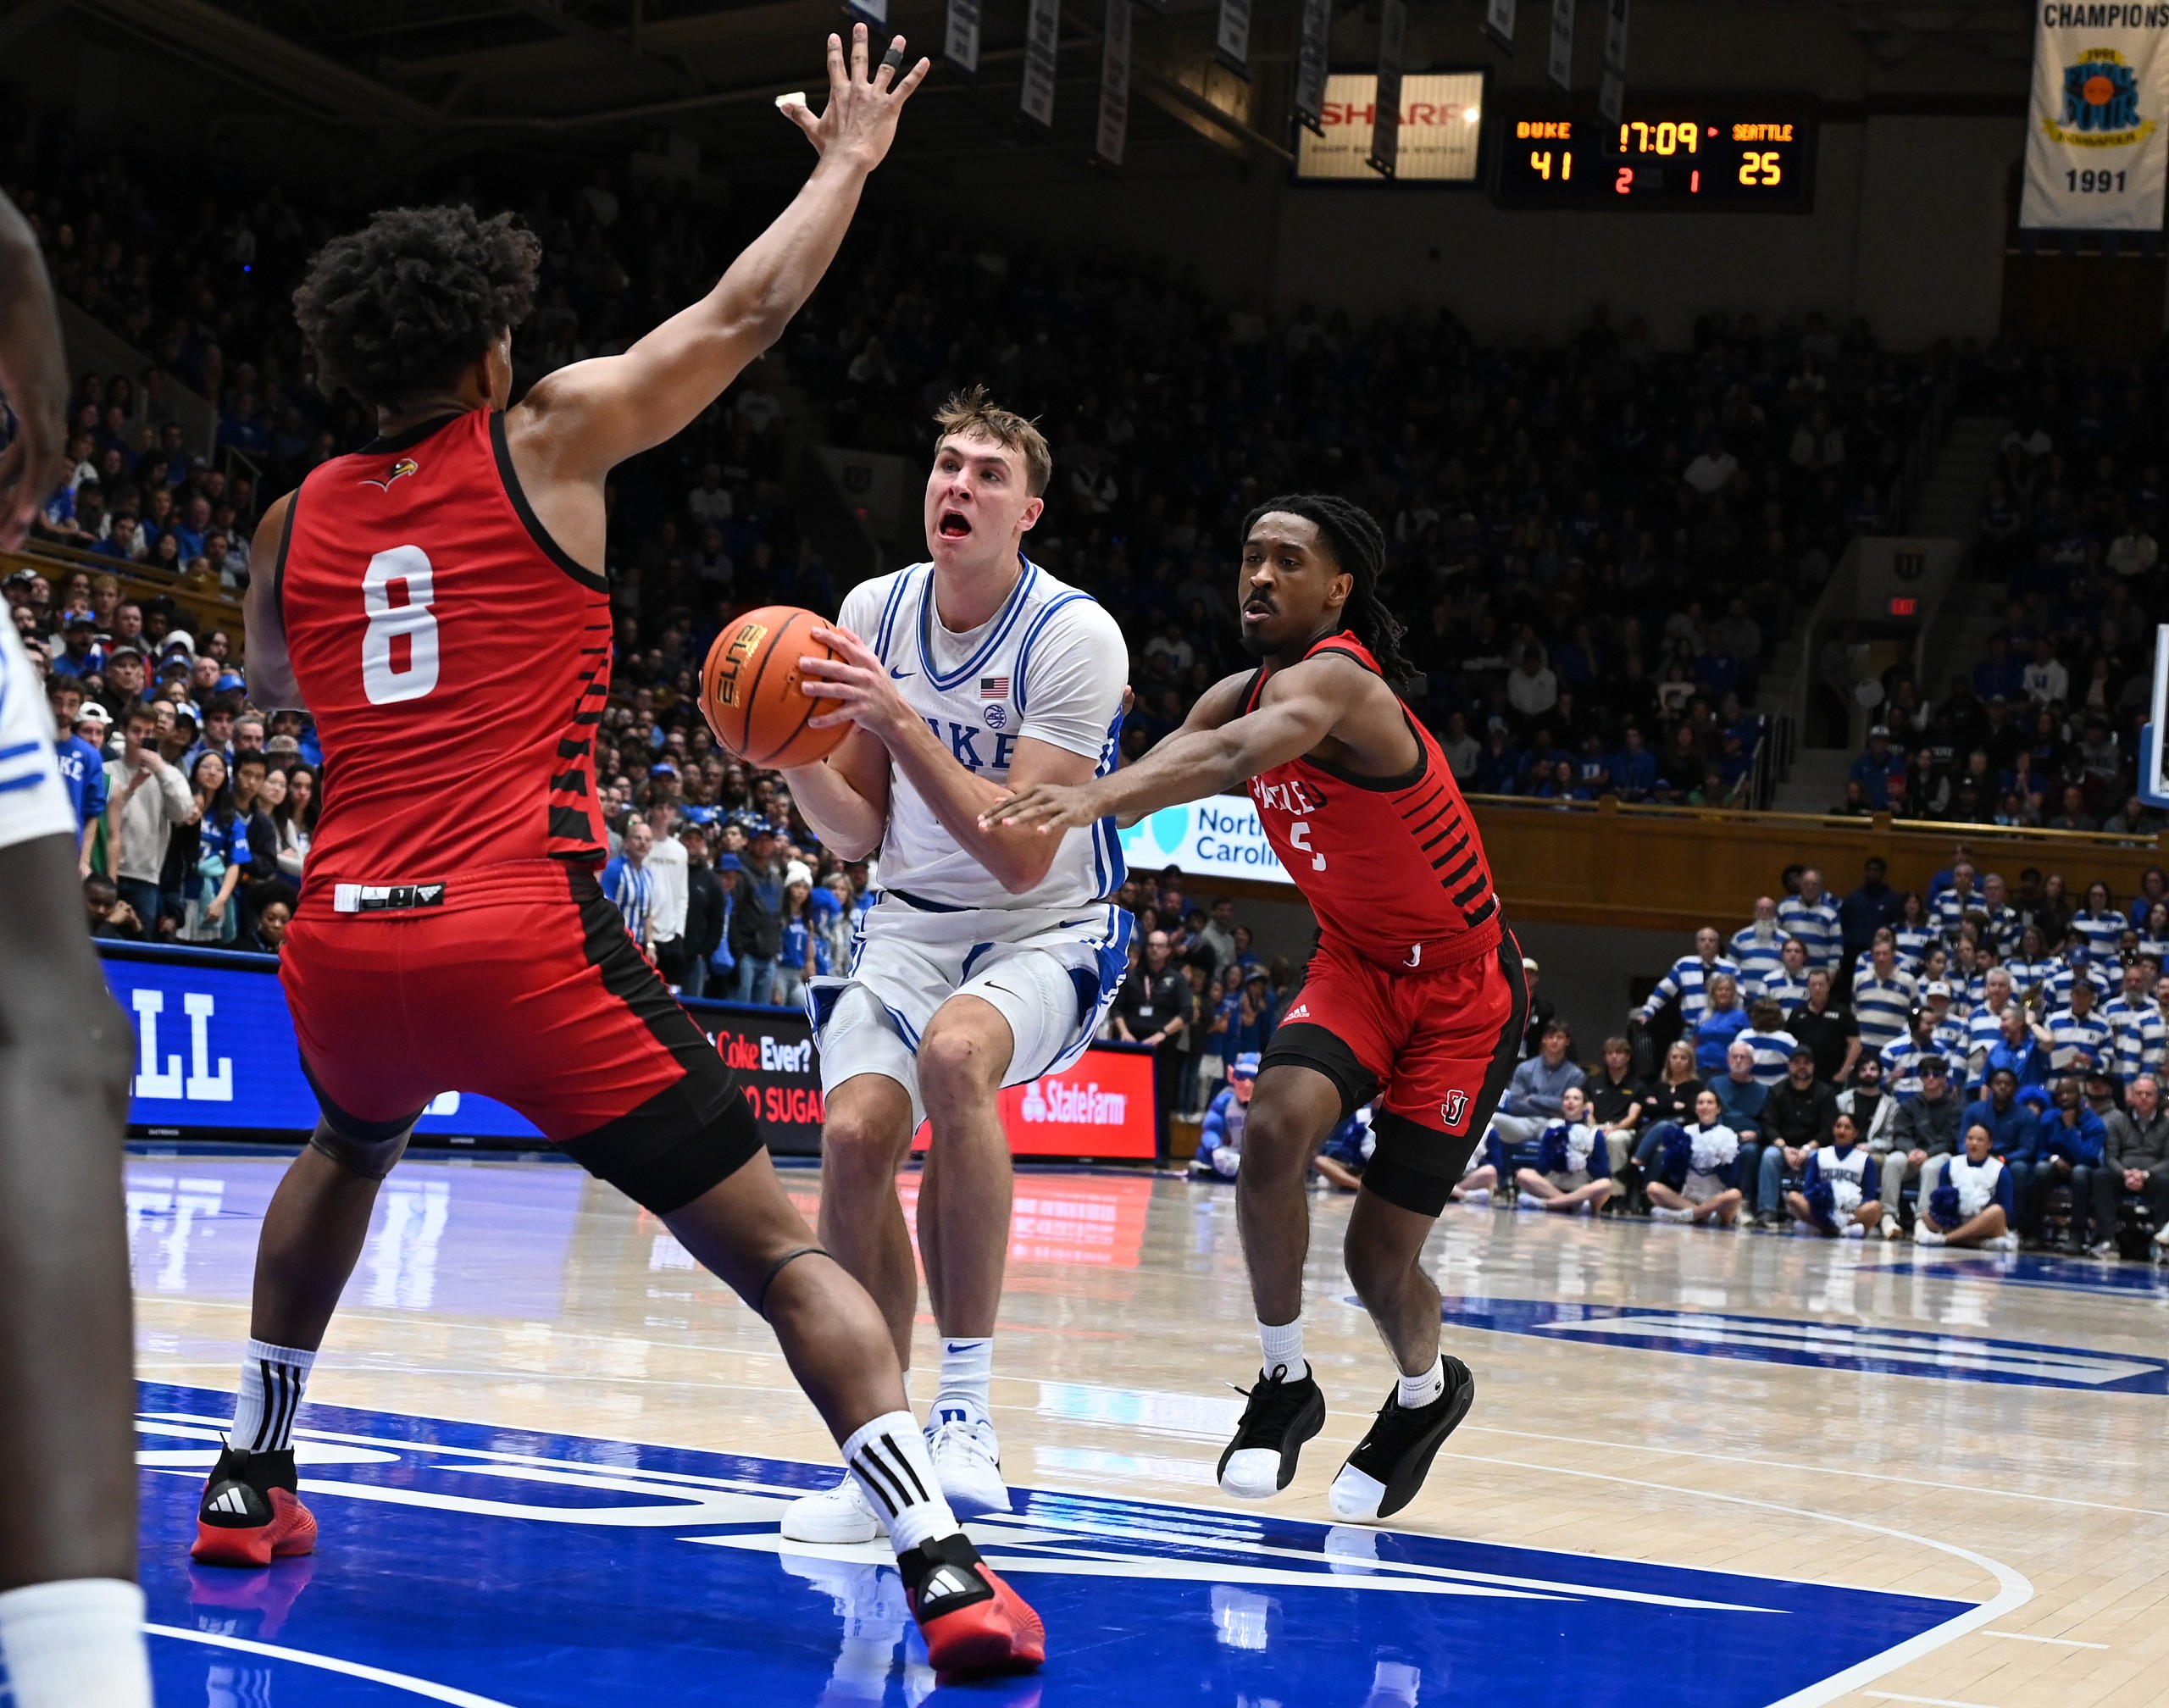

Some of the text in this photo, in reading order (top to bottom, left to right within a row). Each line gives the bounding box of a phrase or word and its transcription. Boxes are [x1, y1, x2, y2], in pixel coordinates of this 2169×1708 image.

[1321, 103, 1466, 126] SHRP
[1517, 121, 1572, 139] DUKE
[1733, 124, 1793, 141] SEATTLE
[1531, 151, 1572, 180] 41
[1616, 168, 1633, 194] 2
[1739, 152, 1781, 185] 25
[2066, 169, 2127, 193] 1991
[1691, 170, 1699, 193] 1
[362, 545, 440, 705] 8
[716, 624, 763, 705] ELITE
[1290, 822, 1327, 871] 5
[129, 989, 233, 1101] LL
[716, 1031, 760, 1070] Coke
[760, 1036, 812, 1072] Ever?
[765, 1086, 825, 1123] SUGA
